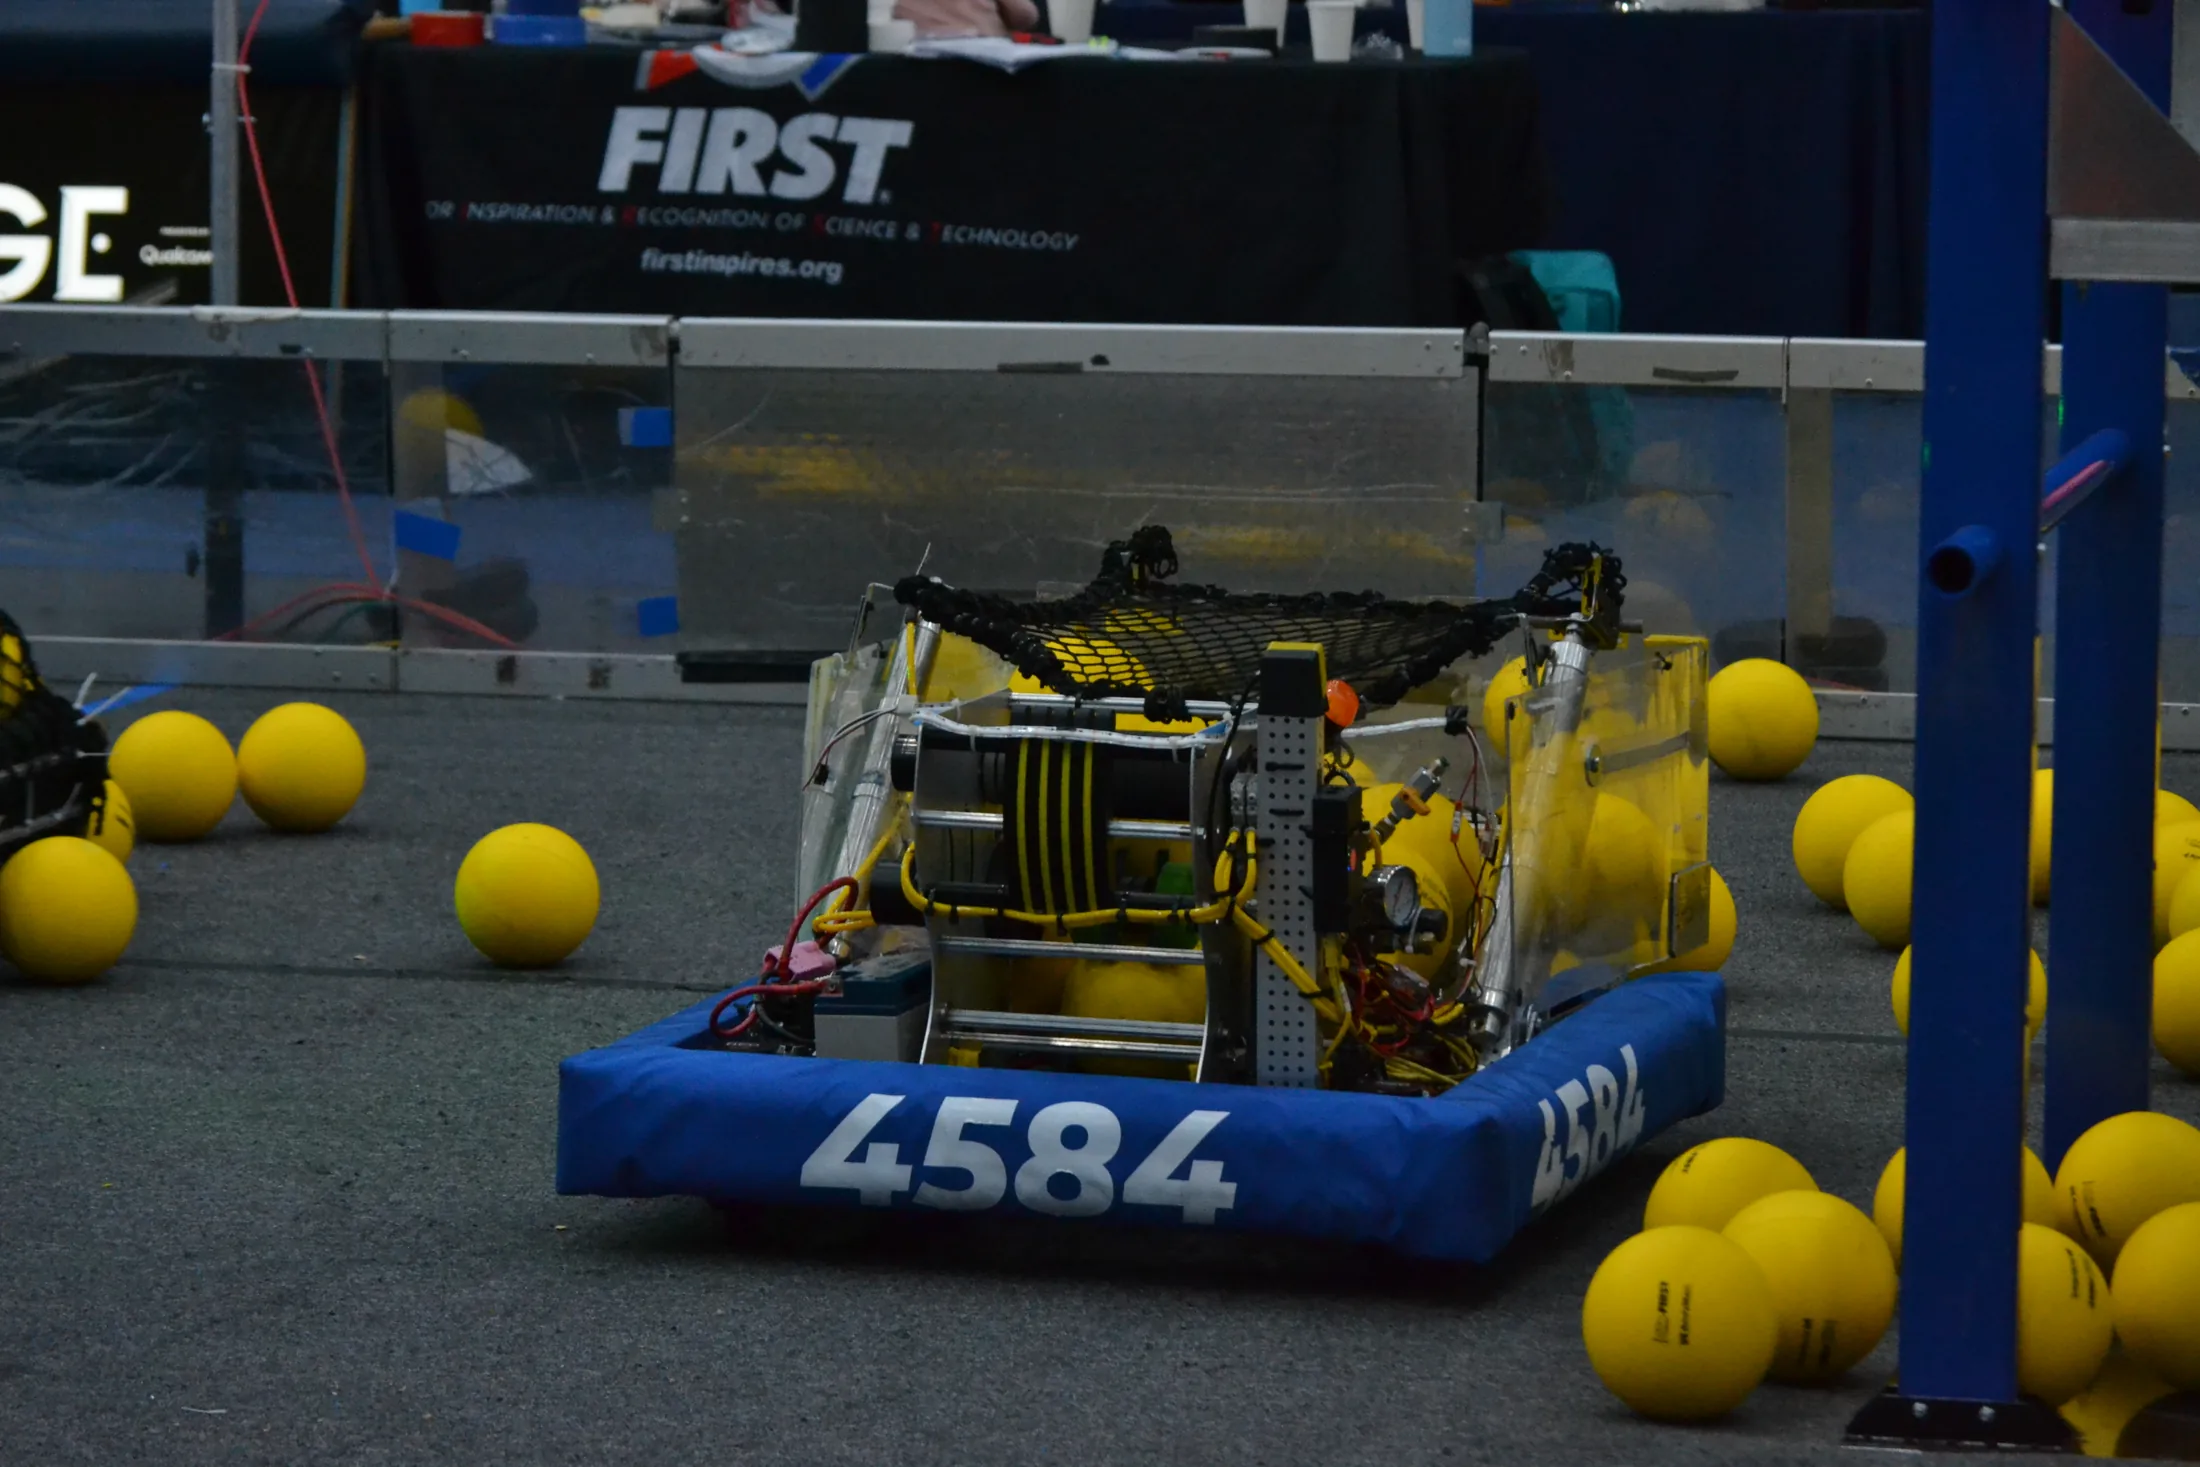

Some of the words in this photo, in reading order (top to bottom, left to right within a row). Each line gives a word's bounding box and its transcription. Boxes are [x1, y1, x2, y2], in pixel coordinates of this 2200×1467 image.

[597, 105, 915, 205] FIRST
[459, 201, 597, 224] INSPIRATION
[600, 204, 616, 226] &
[775, 210, 806, 233] OF
[905, 220, 920, 242] &
[930, 220, 1080, 251] TECHNOLOGY
[641, 247, 844, 286] firstinspires.org
[800, 1092, 1238, 1225] 4584
[1531, 1043, 1646, 1209] 4584
